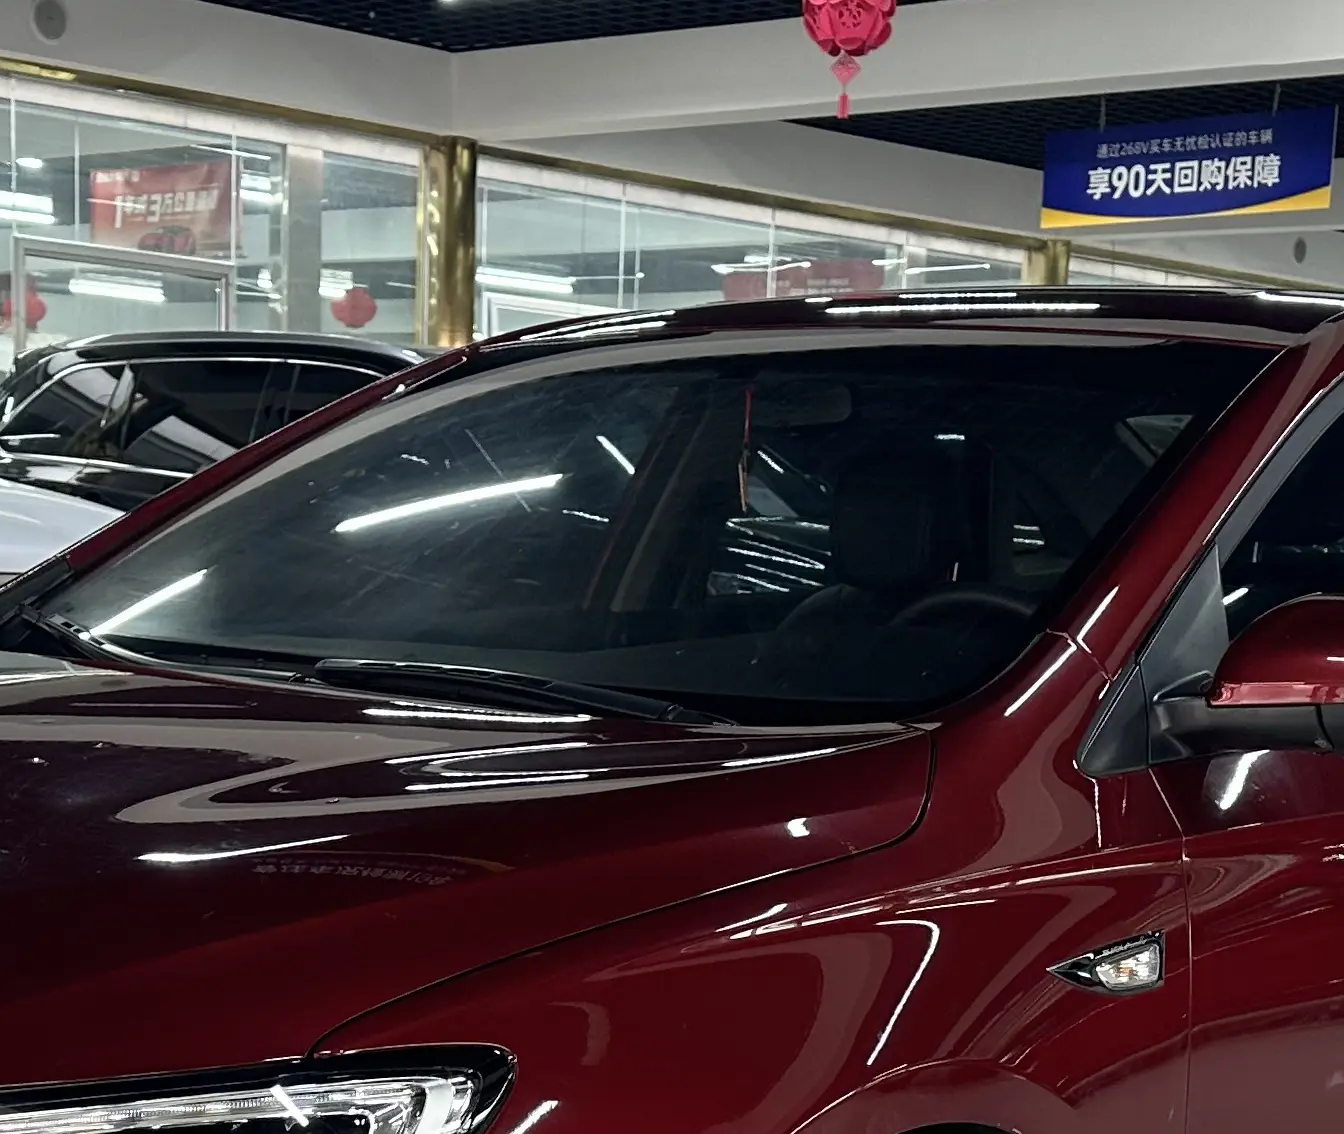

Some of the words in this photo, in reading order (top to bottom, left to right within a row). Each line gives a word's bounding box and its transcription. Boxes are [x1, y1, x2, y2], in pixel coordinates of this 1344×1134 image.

[1086, 154, 1281, 200] 享90天回购保障
